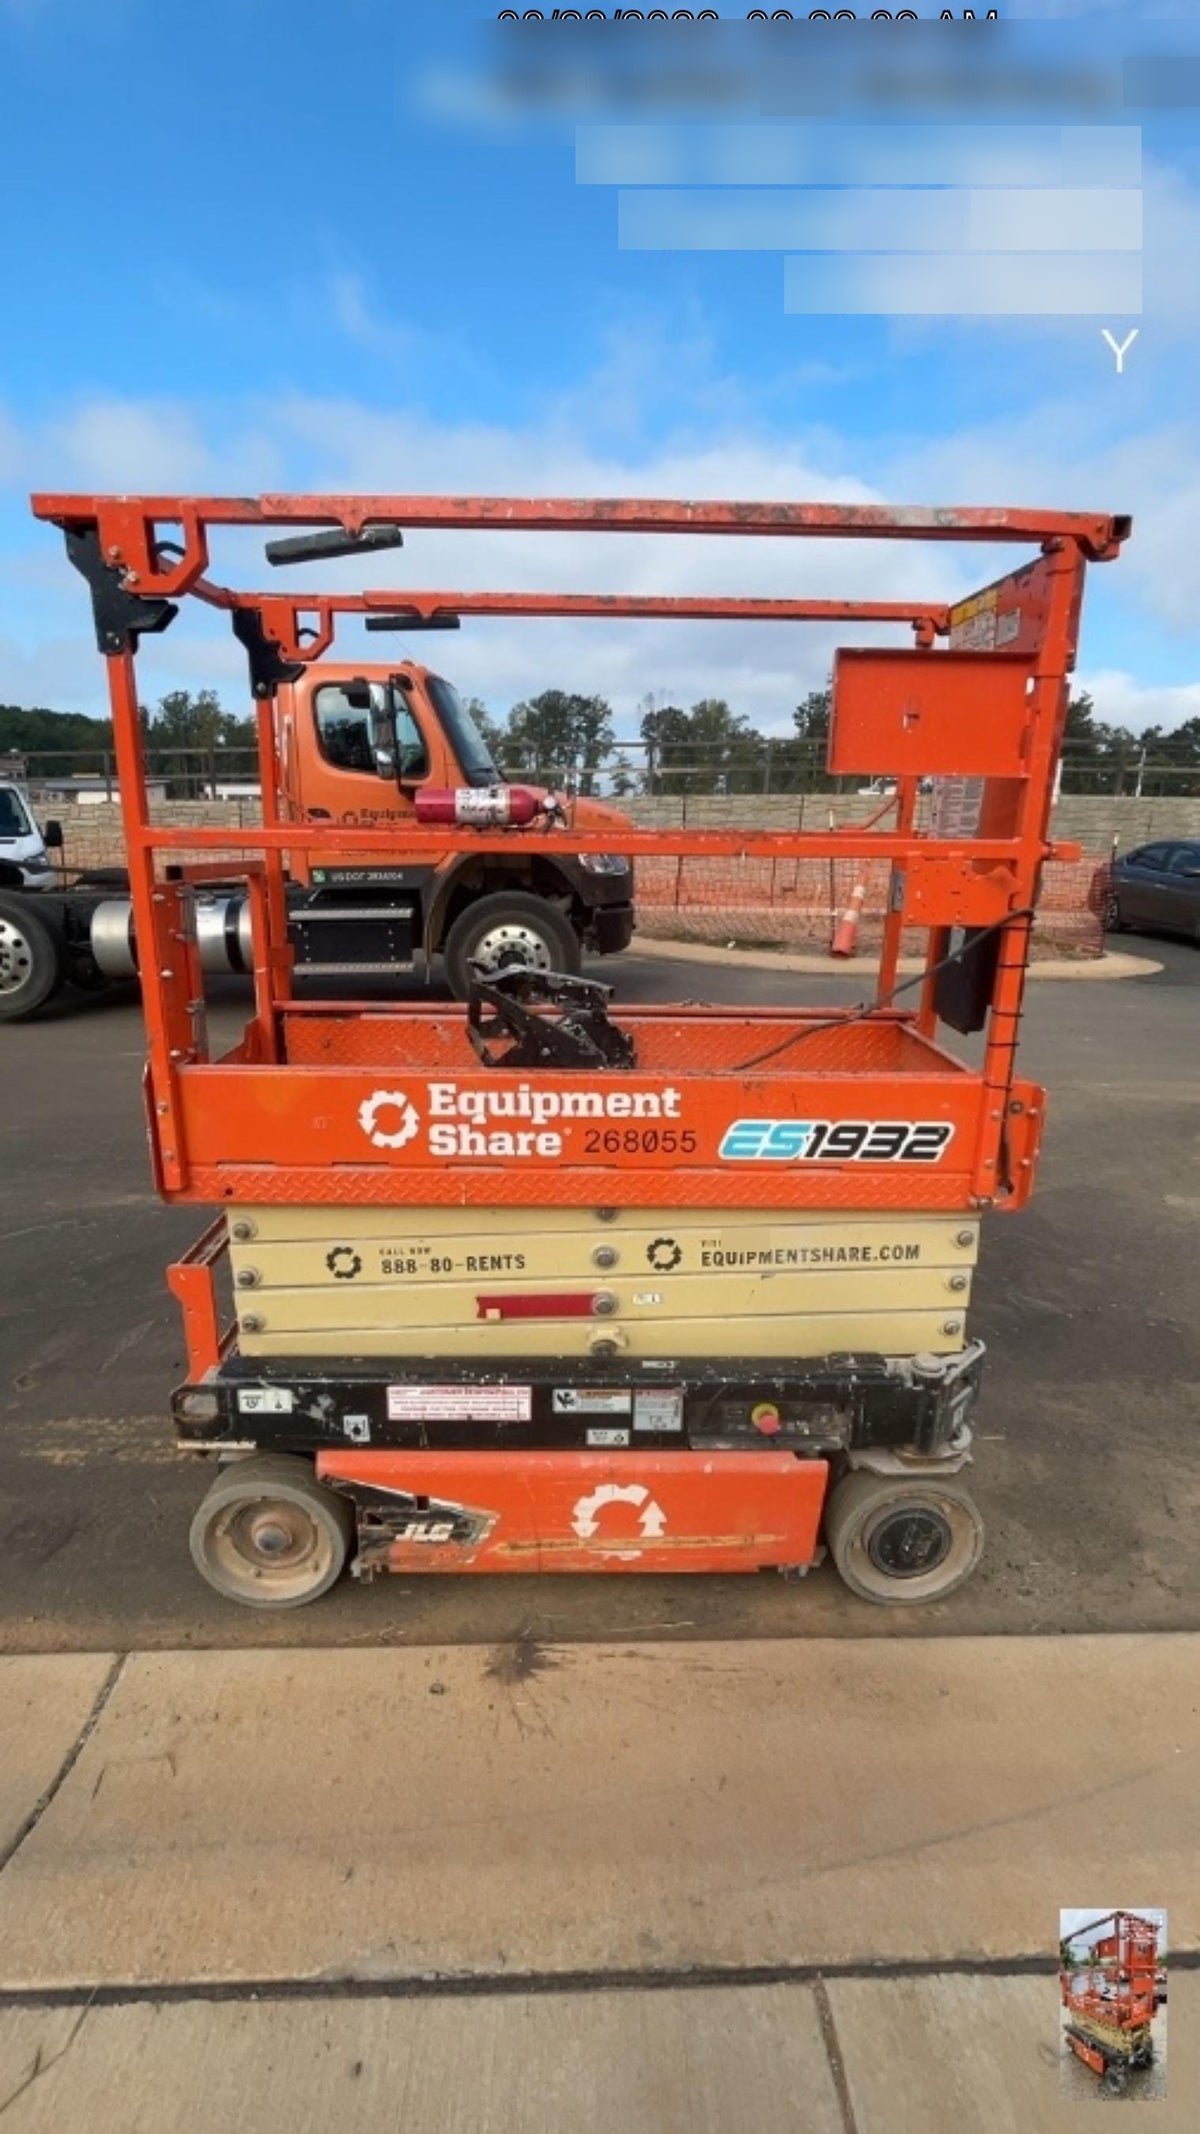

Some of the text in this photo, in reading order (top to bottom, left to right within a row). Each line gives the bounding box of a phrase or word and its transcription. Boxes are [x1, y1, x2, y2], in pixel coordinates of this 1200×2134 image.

[427, 1082, 682, 1125] Equipment
[427, 1122, 563, 1157] Share
[583, 1128, 698, 1154] 268055
[720, 1122, 952, 1161] ES1932
[381, 1254, 526, 1275] 888-80-RENTS
[701, 1244, 921, 1267] EQUIPMENTSHARE.COM
[395, 1523, 454, 1542] JLG
